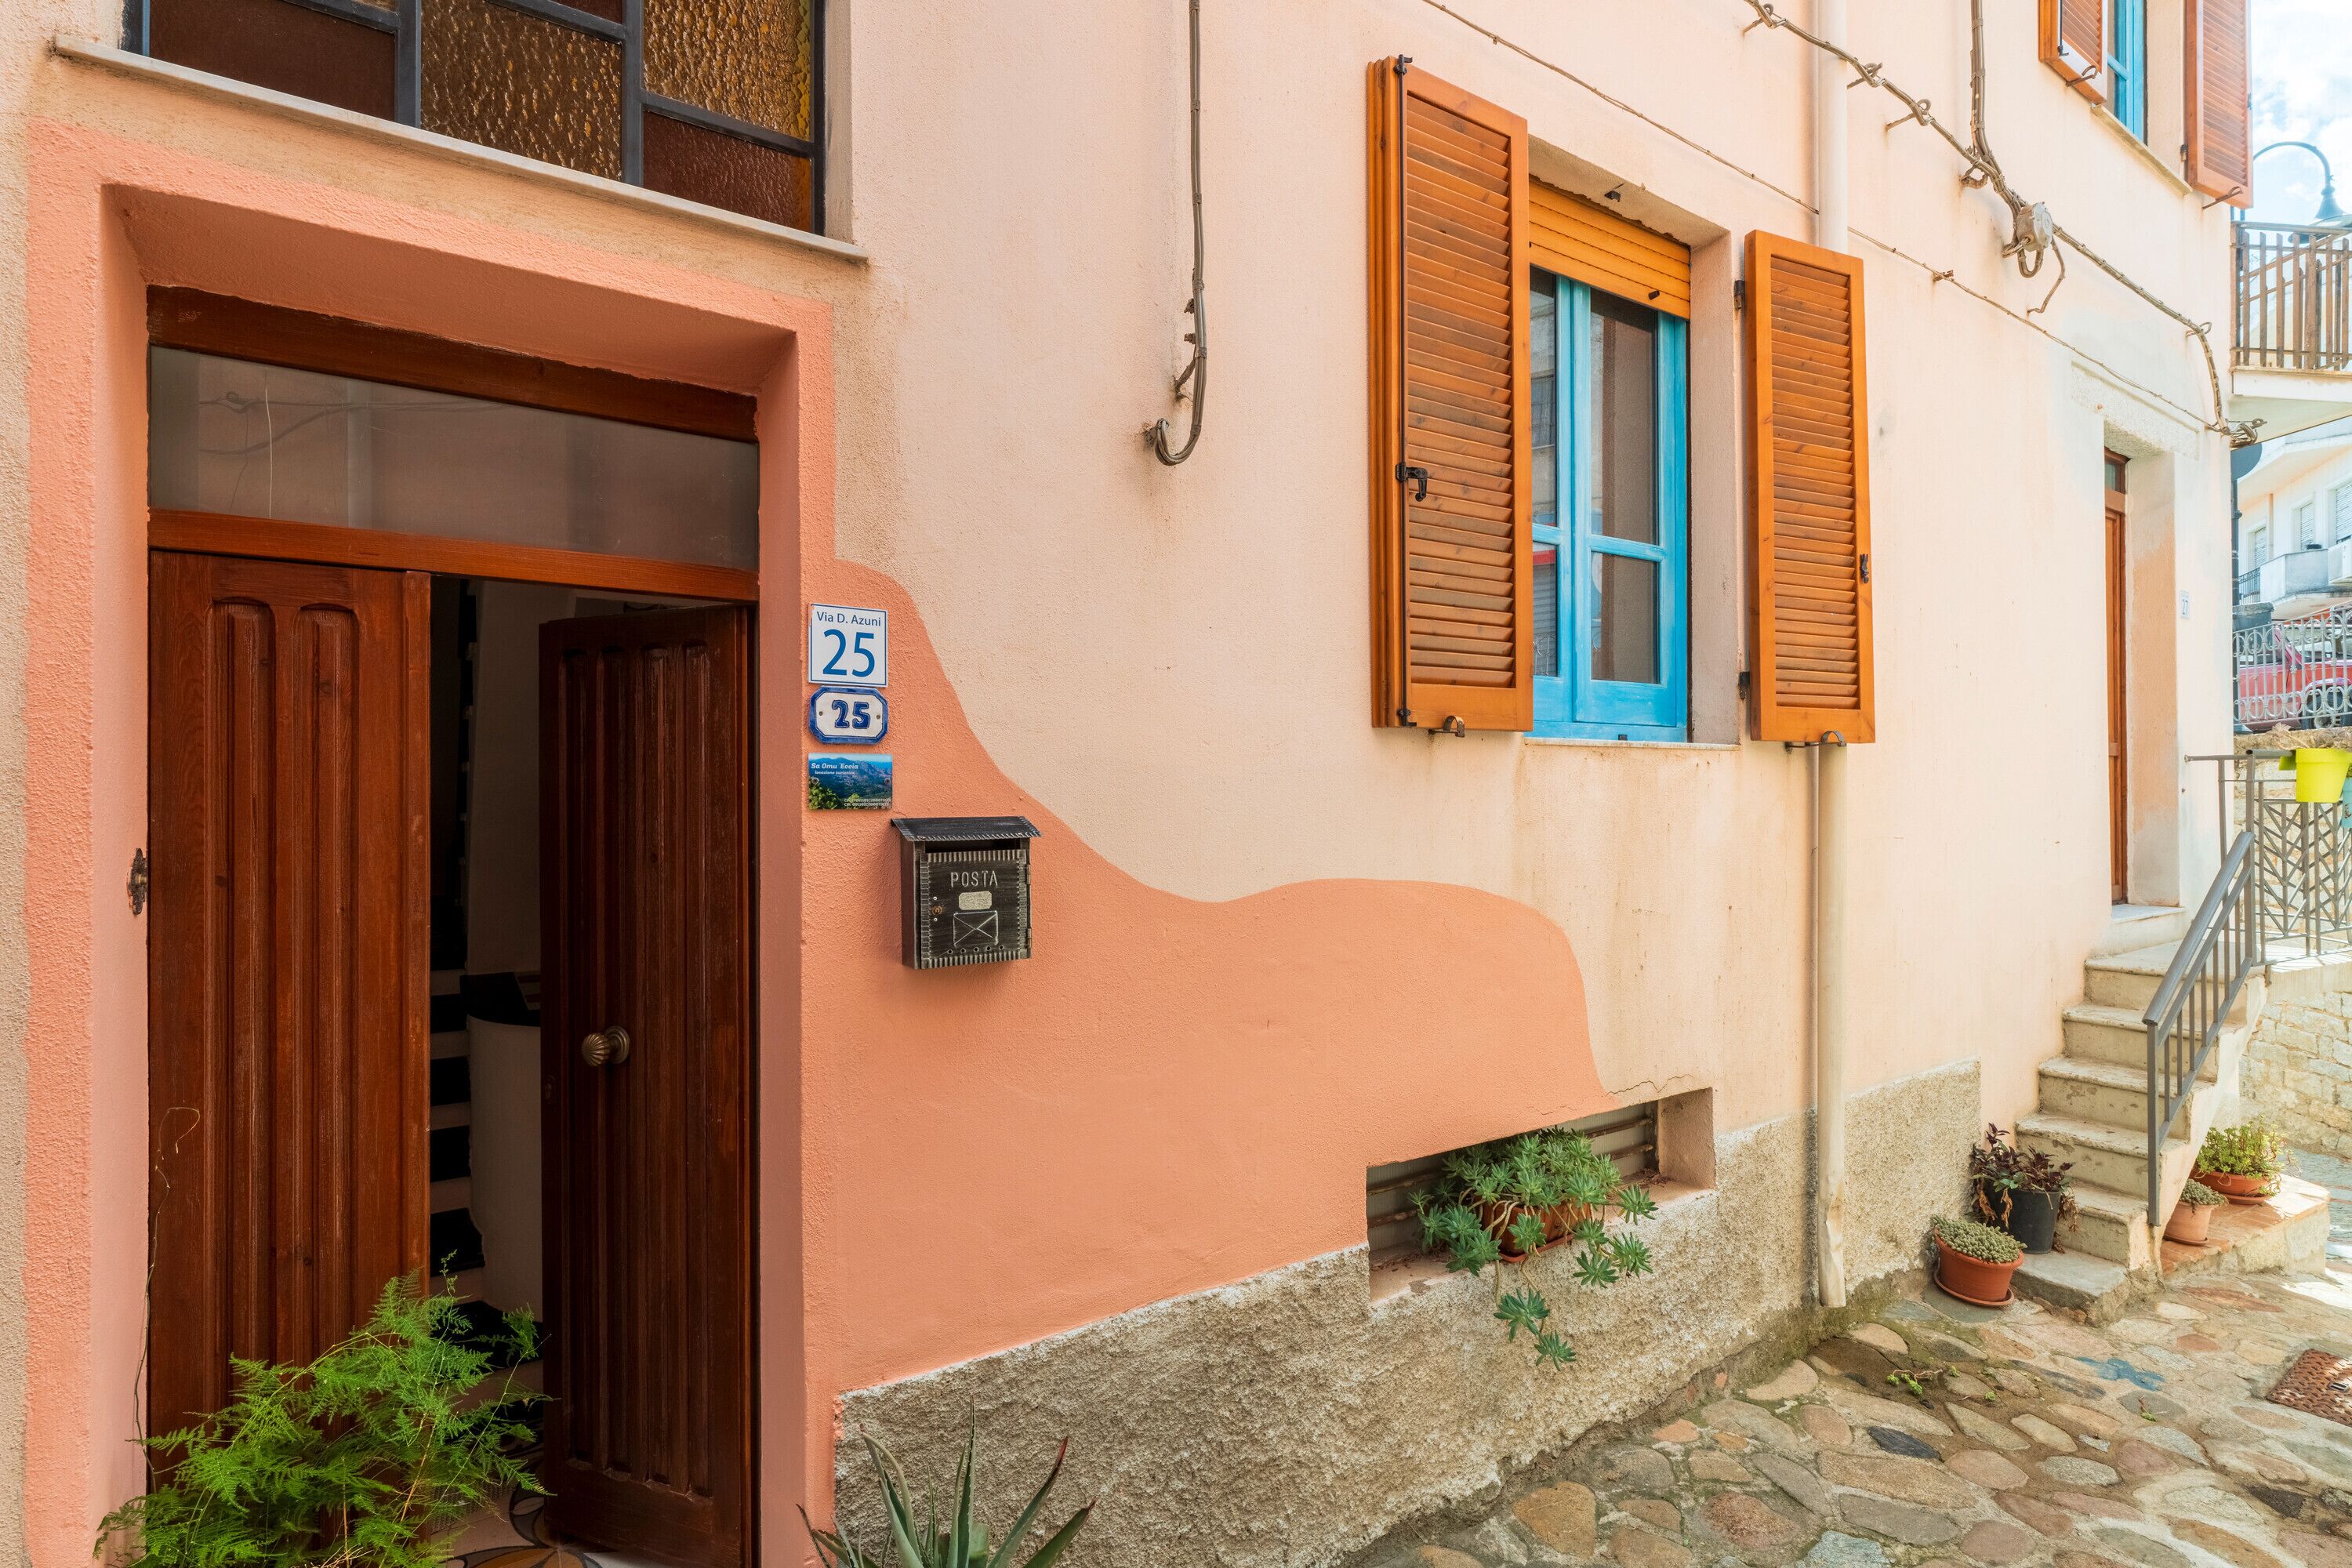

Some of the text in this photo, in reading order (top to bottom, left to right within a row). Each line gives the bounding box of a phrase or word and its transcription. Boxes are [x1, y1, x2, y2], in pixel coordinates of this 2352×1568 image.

[816, 611, 881, 626] Via D. Azuni
[822, 629, 876, 677] 25
[831, 699, 871, 729] 25
[950, 870, 998, 887] POSTA
